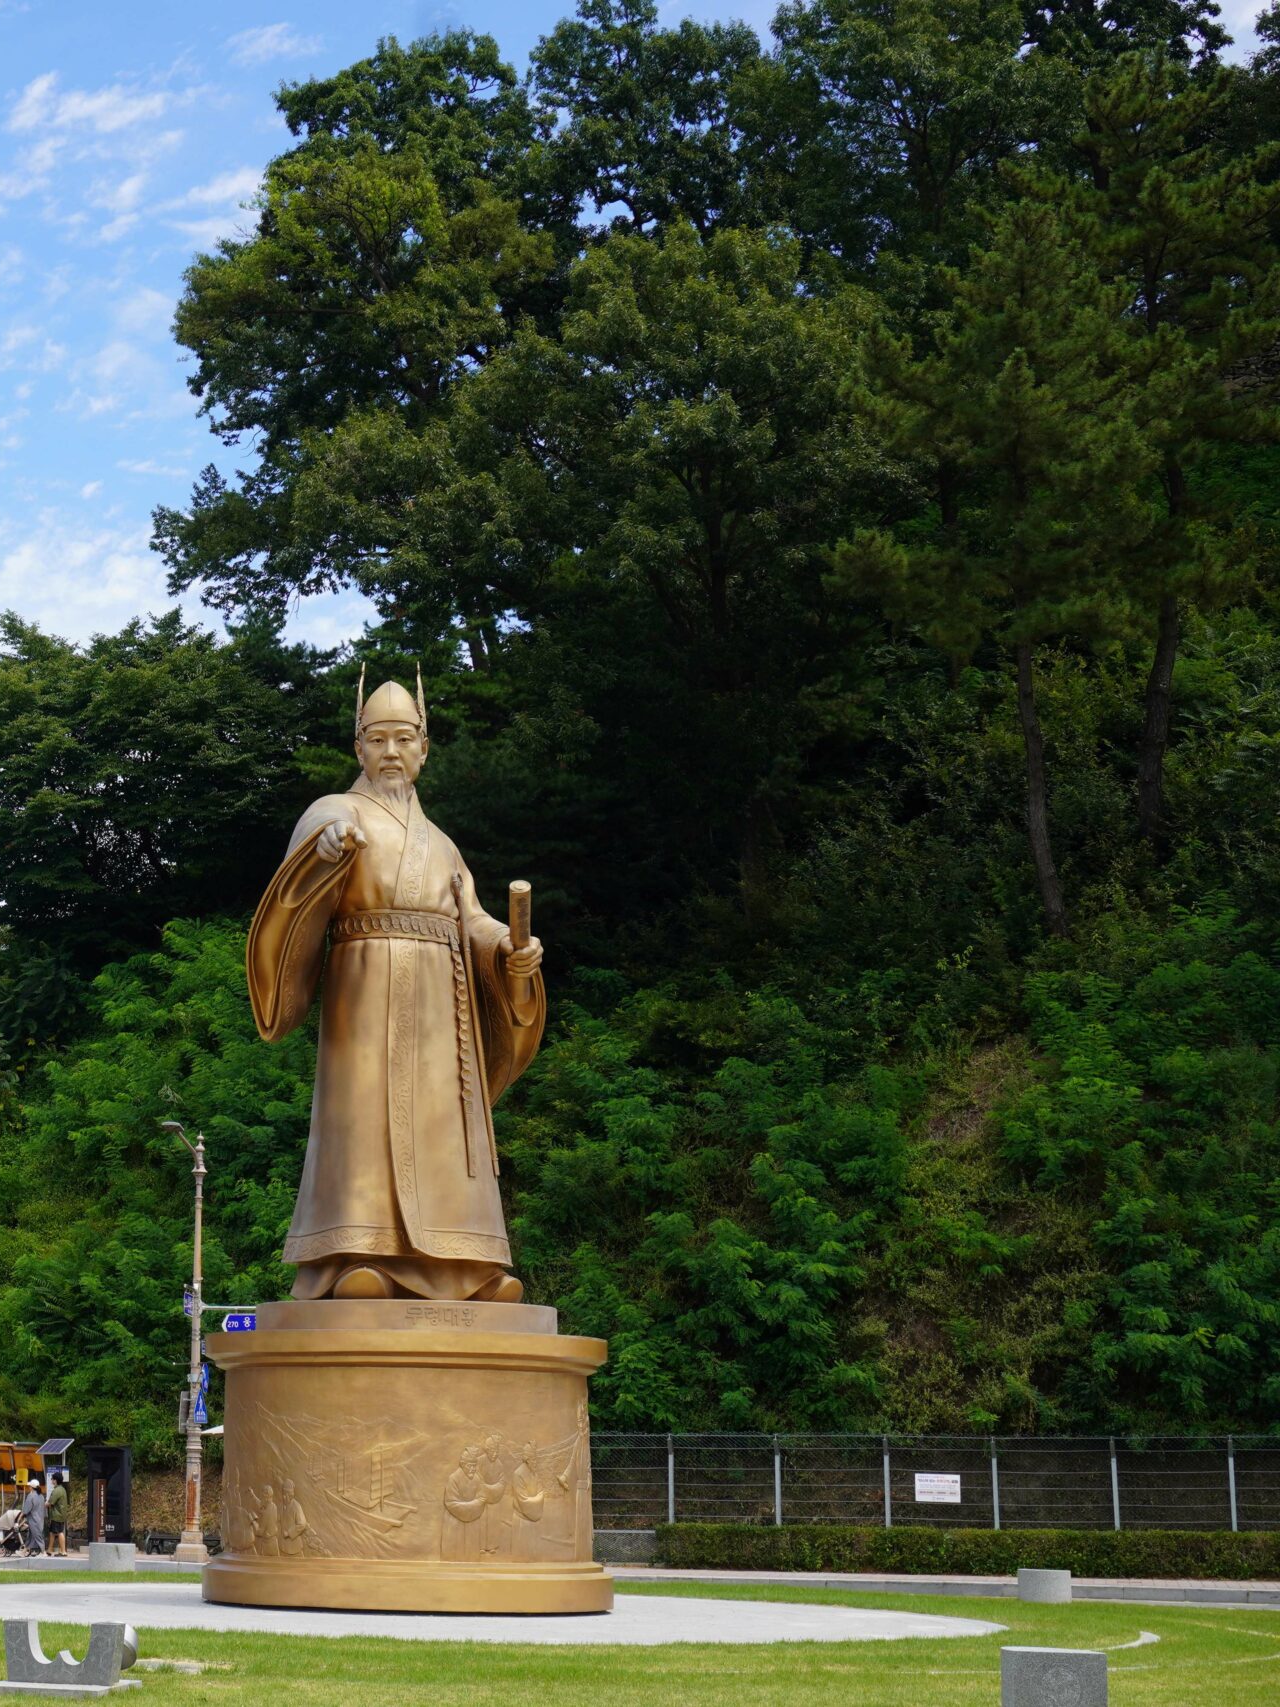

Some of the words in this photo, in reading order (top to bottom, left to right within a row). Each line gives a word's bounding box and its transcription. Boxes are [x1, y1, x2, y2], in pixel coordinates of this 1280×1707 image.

[227, 1320, 239, 1328] 270
[242, 1316, 257, 1328] 웅
[404, 1306, 478, 1327] 무령대왕
